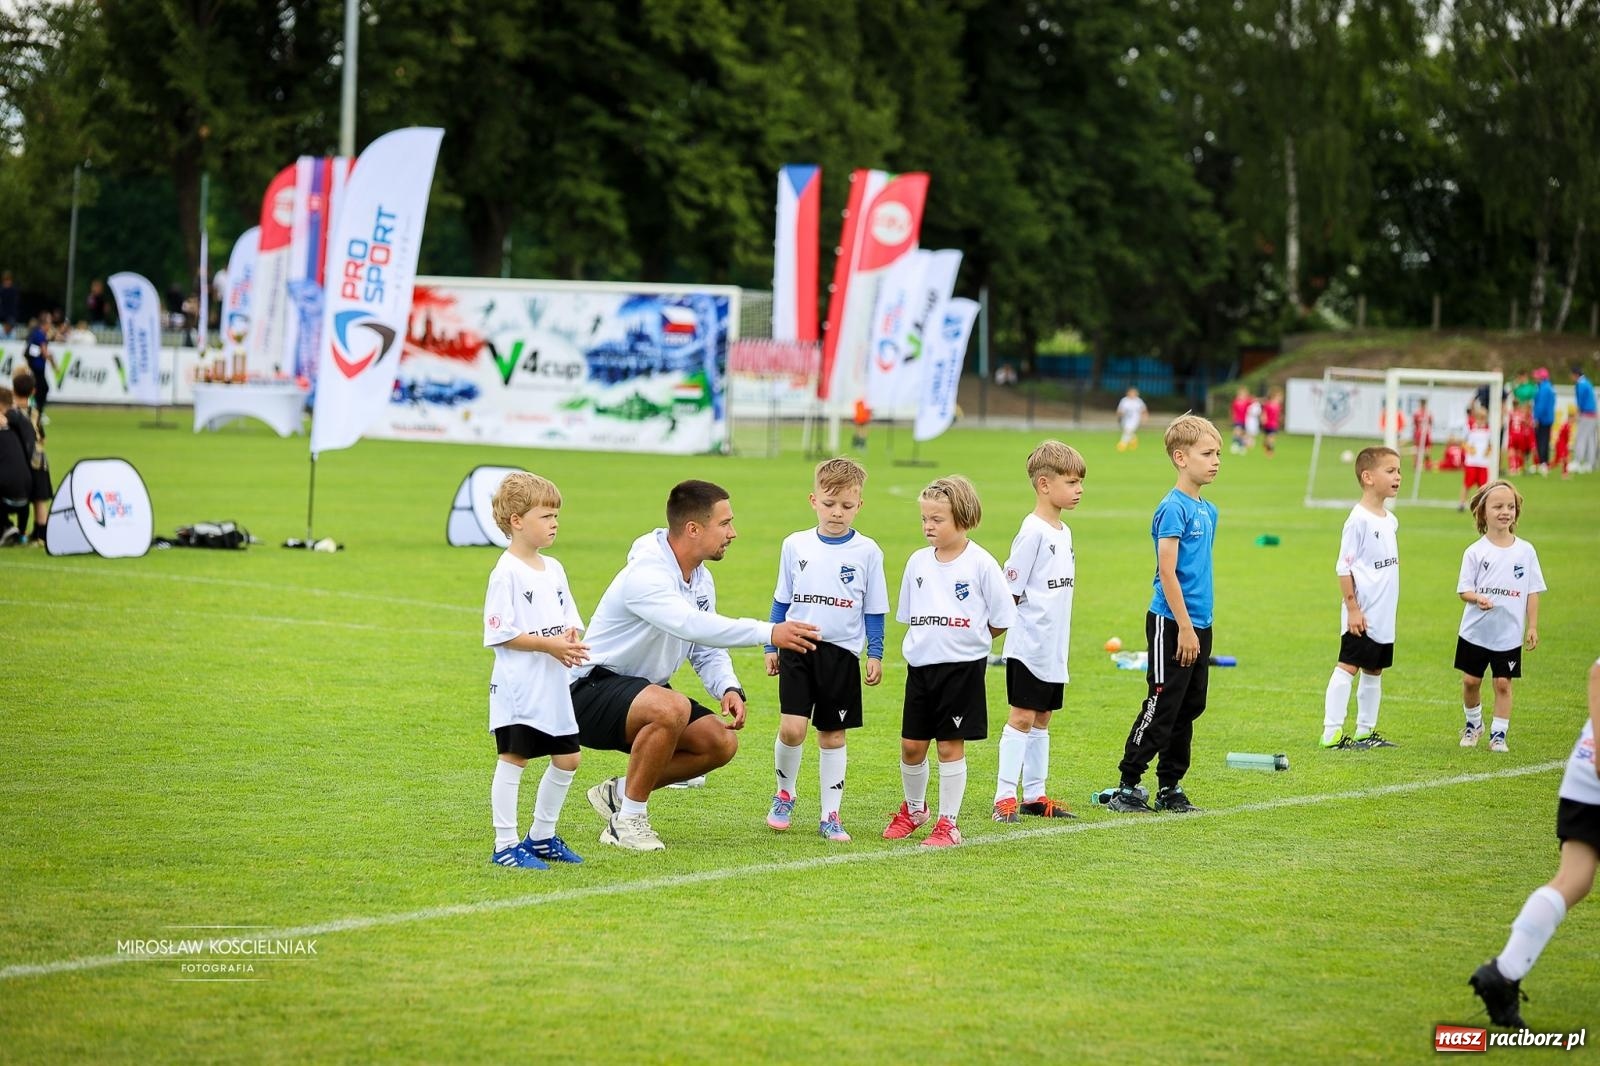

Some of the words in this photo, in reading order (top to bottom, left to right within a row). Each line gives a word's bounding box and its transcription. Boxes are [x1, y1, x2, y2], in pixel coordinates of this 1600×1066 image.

[341, 239, 367, 300] PRO
[364, 204, 396, 303] SPORT
[794, 594, 853, 609] ELEKTROLEX
[911, 616, 970, 629] ELEKTROLEX
